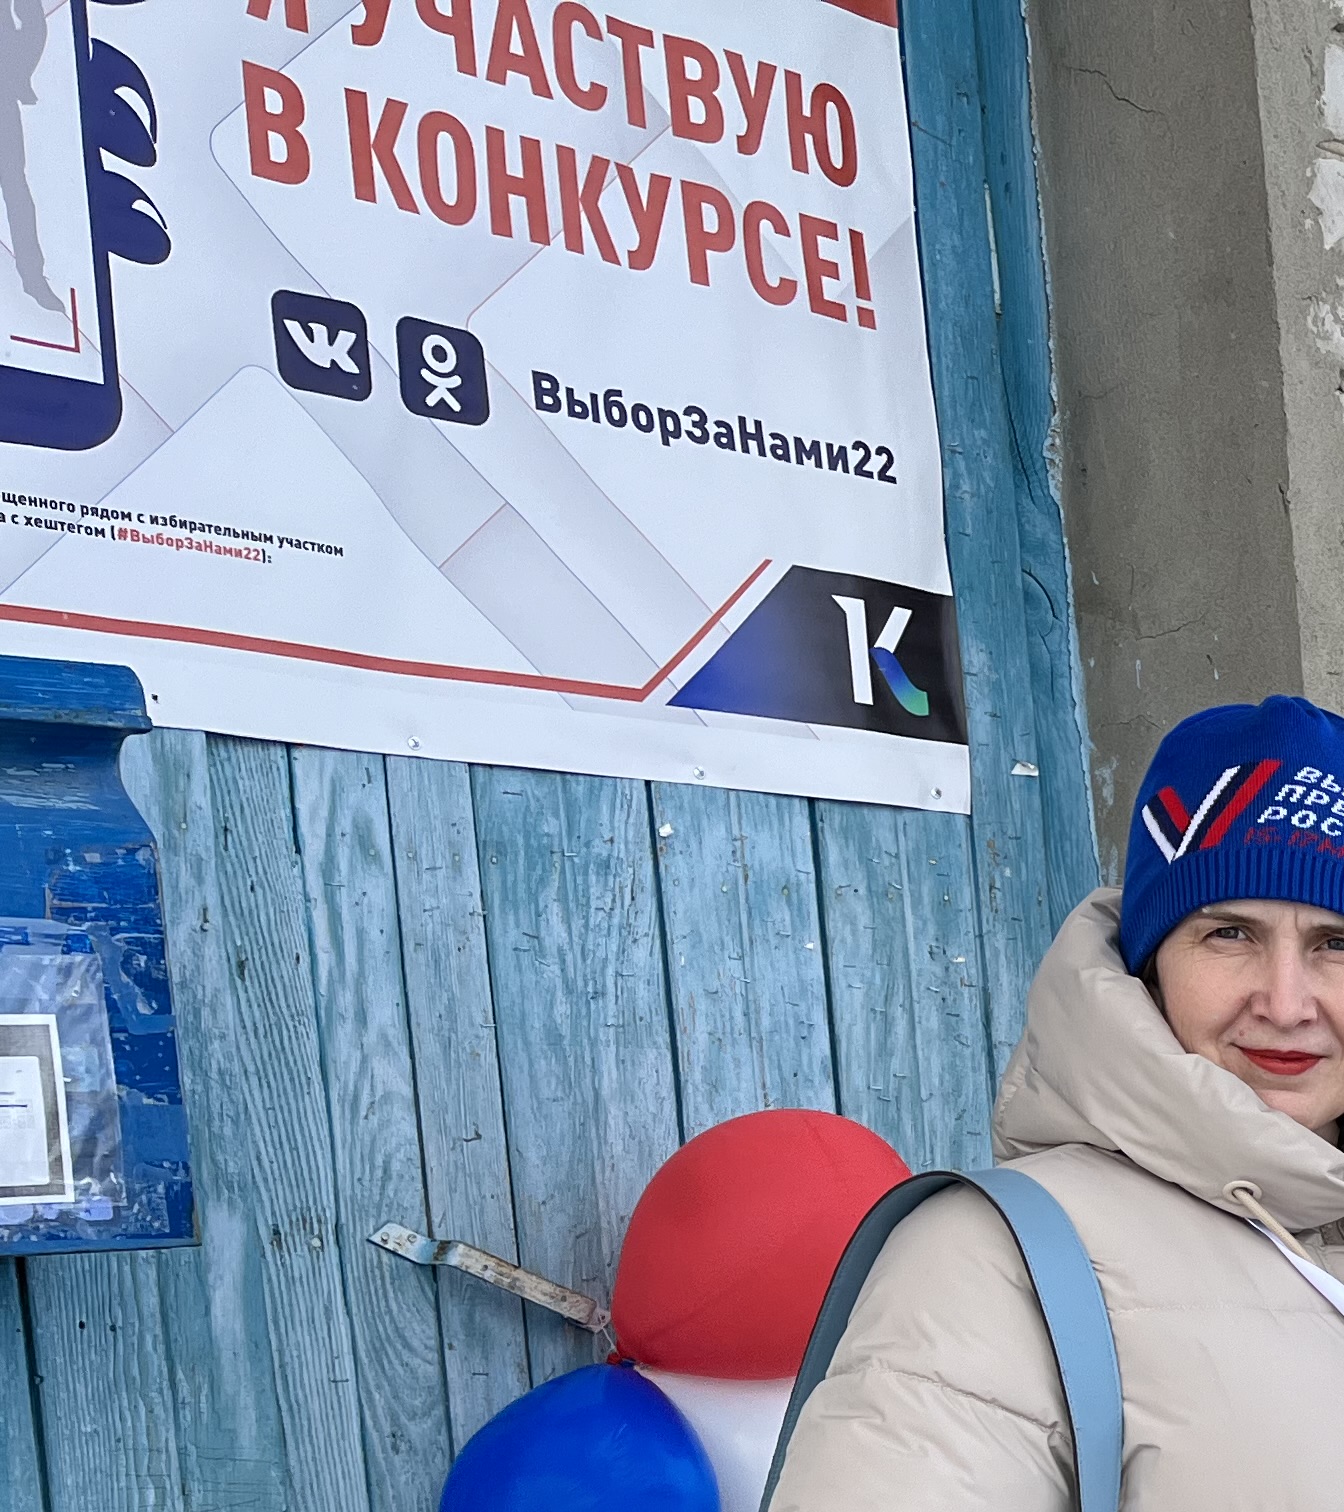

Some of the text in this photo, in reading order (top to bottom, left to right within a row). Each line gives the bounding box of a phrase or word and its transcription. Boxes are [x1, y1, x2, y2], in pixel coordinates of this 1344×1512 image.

[242, 59, 877, 330] В КОНКУРСЕ!
[531, 369, 898, 485] ВыборЗаНами22
[10, 513, 20, 525] с
[23, 515, 107, 539] хештегом
[80, 504, 132, 522] рядом
[136, 512, 146, 524] с
[149, 514, 274, 545] избирательным
[277, 535, 344, 557] участком
